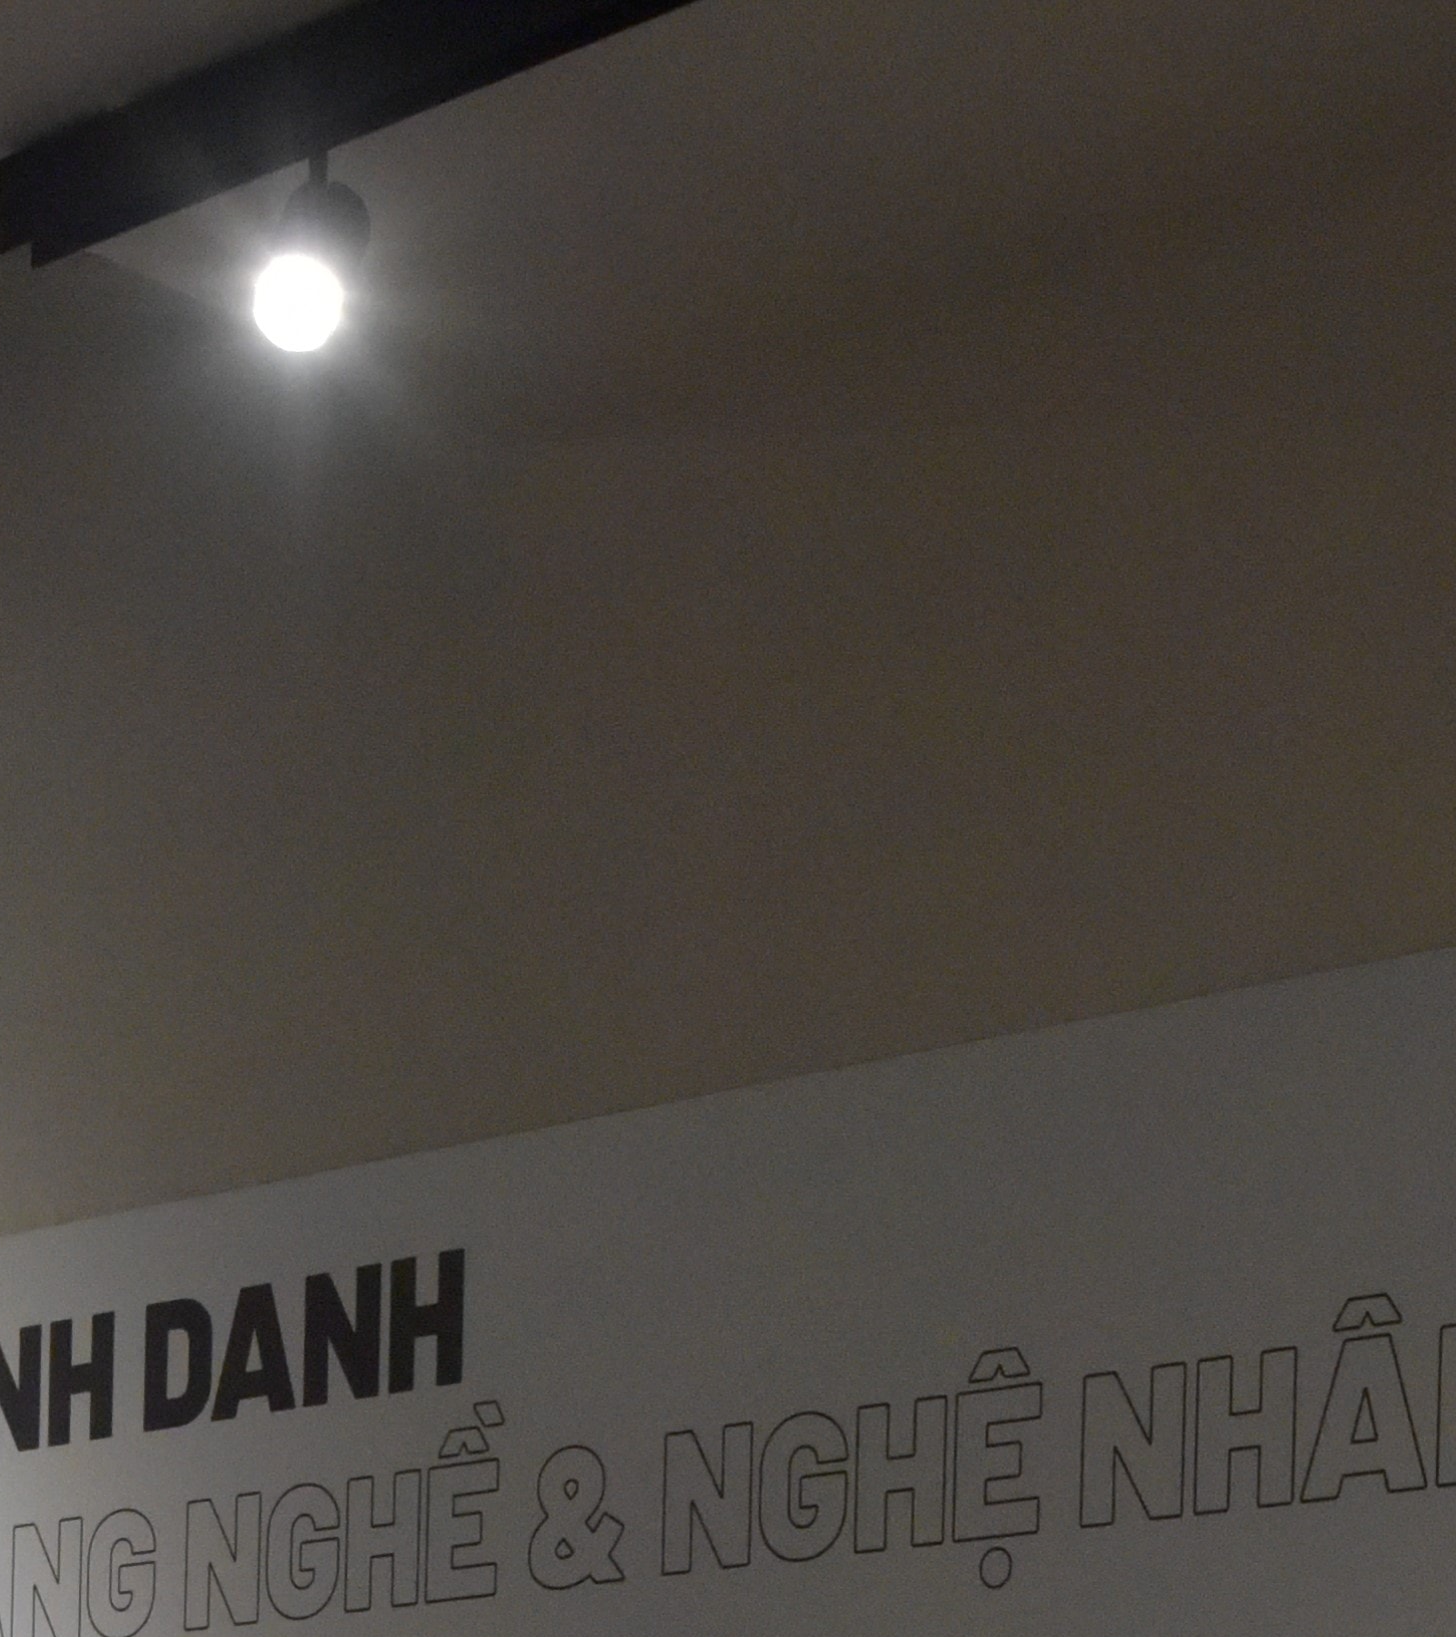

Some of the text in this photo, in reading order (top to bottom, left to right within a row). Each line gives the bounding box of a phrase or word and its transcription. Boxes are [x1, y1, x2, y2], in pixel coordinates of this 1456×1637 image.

[142, 1248, 466, 1433] DANH
[183, 1400, 506, 1632] NGHỀ
[527, 1443, 626, 1590] &
[660, 1346, 1043, 1589] NGHỆ
